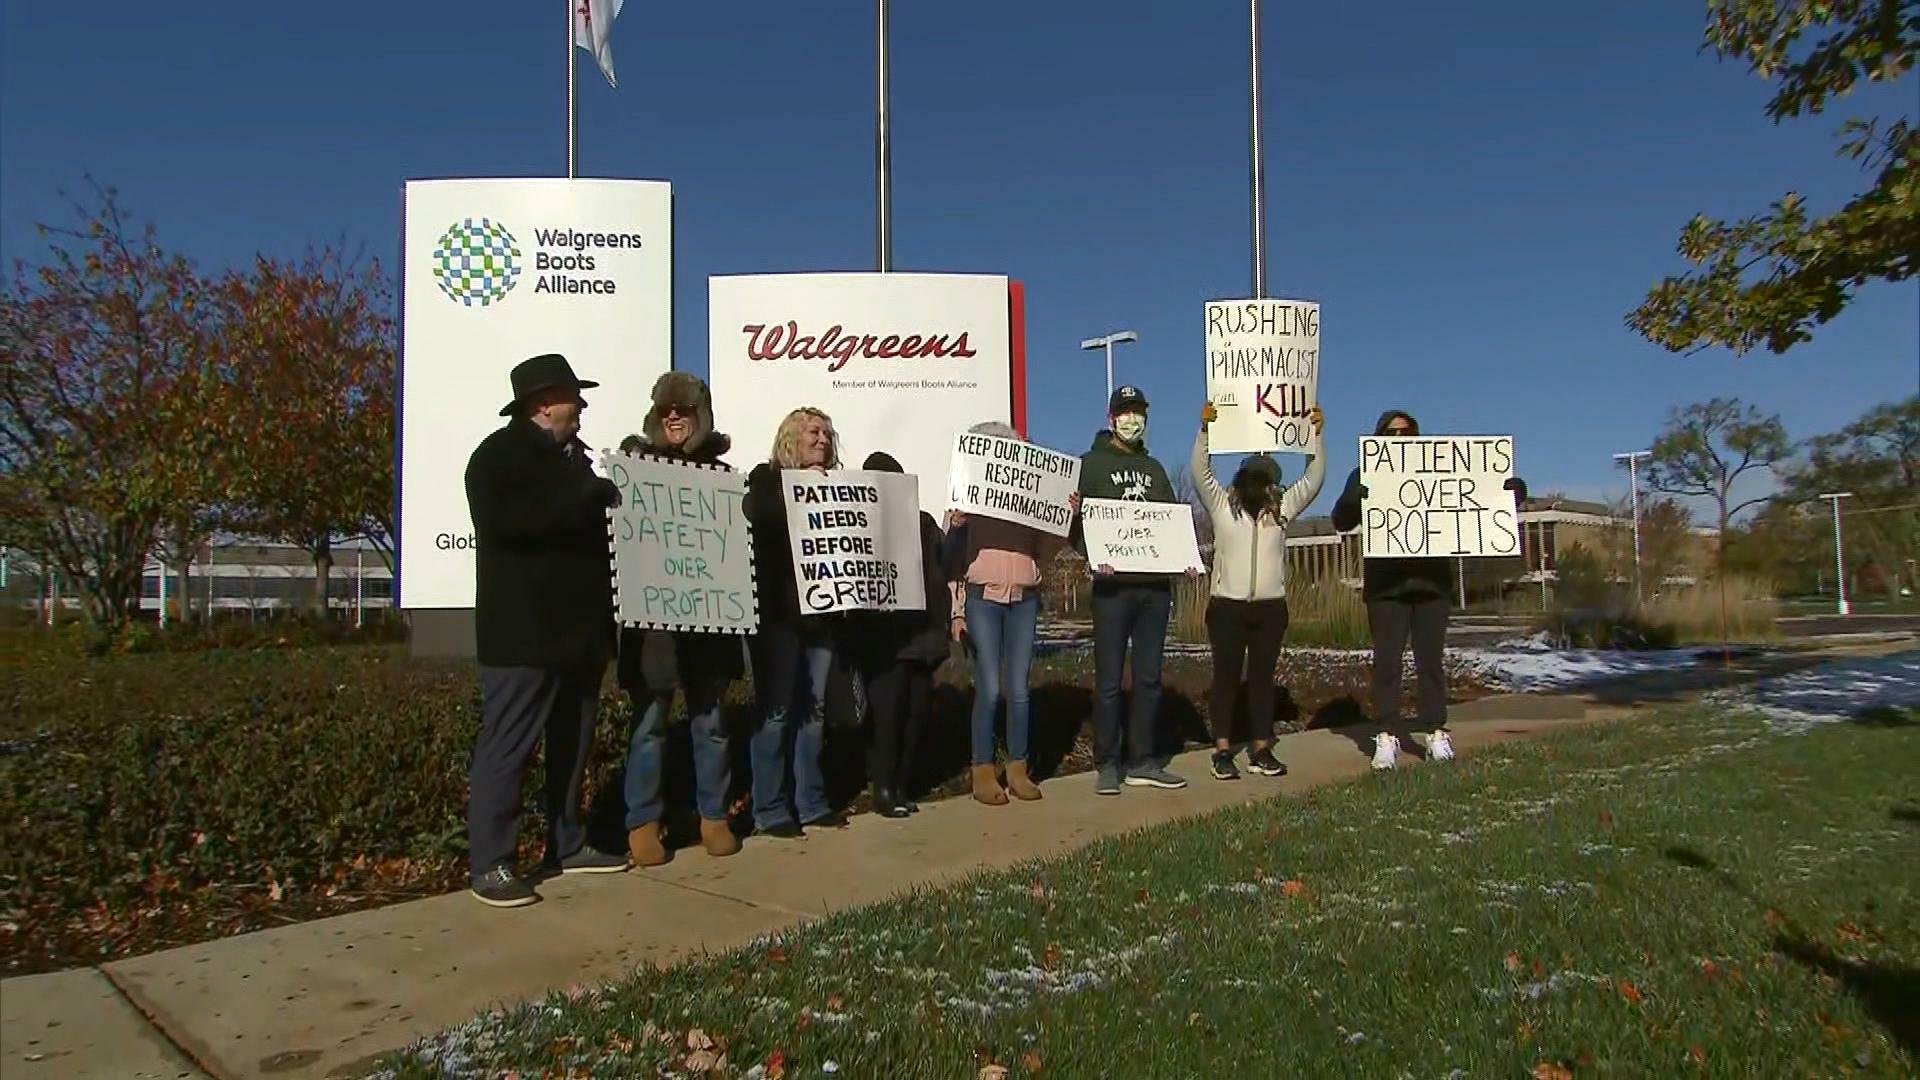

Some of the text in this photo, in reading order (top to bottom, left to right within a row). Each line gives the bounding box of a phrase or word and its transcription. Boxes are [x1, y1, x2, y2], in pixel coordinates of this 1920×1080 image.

[534, 228, 642, 251] Walgreens
[536, 252, 596, 271] Boots
[534, 275, 616, 294] Alliance
[1208, 304, 1318, 338] RUSHING
[742, 320, 977, 372] Walgreens
[1211, 346, 1317, 382] PHARMACIST
[832, 380, 977, 390] Member of Walgreens Boots Alliance
[1256, 383, 1311, 418] KILL
[1265, 420, 1311, 447] YOU
[958, 435, 992, 456] KEEP
[994, 440, 1021, 463] OUR
[1362, 439, 1511, 474] PATIENTS
[985, 462, 1042, 494] RESPECT
[1110, 469, 1152, 487] MAINE
[612, 464, 744, 526] PATIENT
[793, 485, 878, 504] PATIENTS
[1399, 478, 1482, 508] OVER
[807, 510, 868, 530] NEEDS
[1081, 503, 1173, 520] PATIENT SAFETY
[622, 517, 727, 563] SAFETY
[1367, 507, 1516, 554] PROFITS
[801, 536, 873, 556] BEFORE
[664, 557, 714, 580] OVER
[800, 560, 898, 580] WALGREENS
[642, 585, 745, 621] PROFITS
[806, 580, 897, 611] GREED!!
